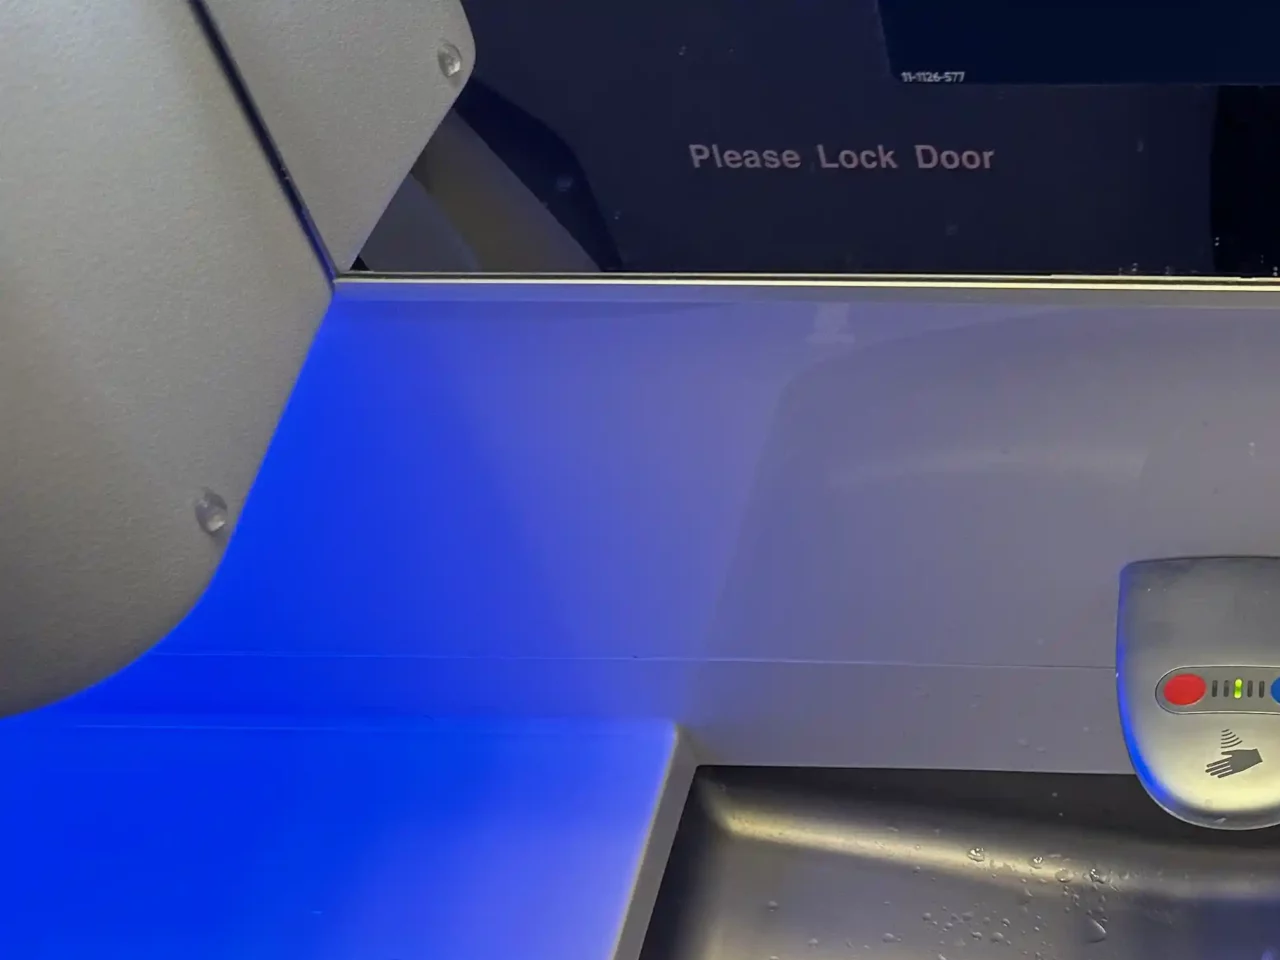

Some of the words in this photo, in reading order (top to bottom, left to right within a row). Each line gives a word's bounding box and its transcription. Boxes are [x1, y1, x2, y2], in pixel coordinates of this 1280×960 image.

[901, 71, 965, 83] 11-1126-577
[688, 144, 801, 169] Please
[816, 144, 898, 169] Lock
[914, 144, 995, 169] Door
